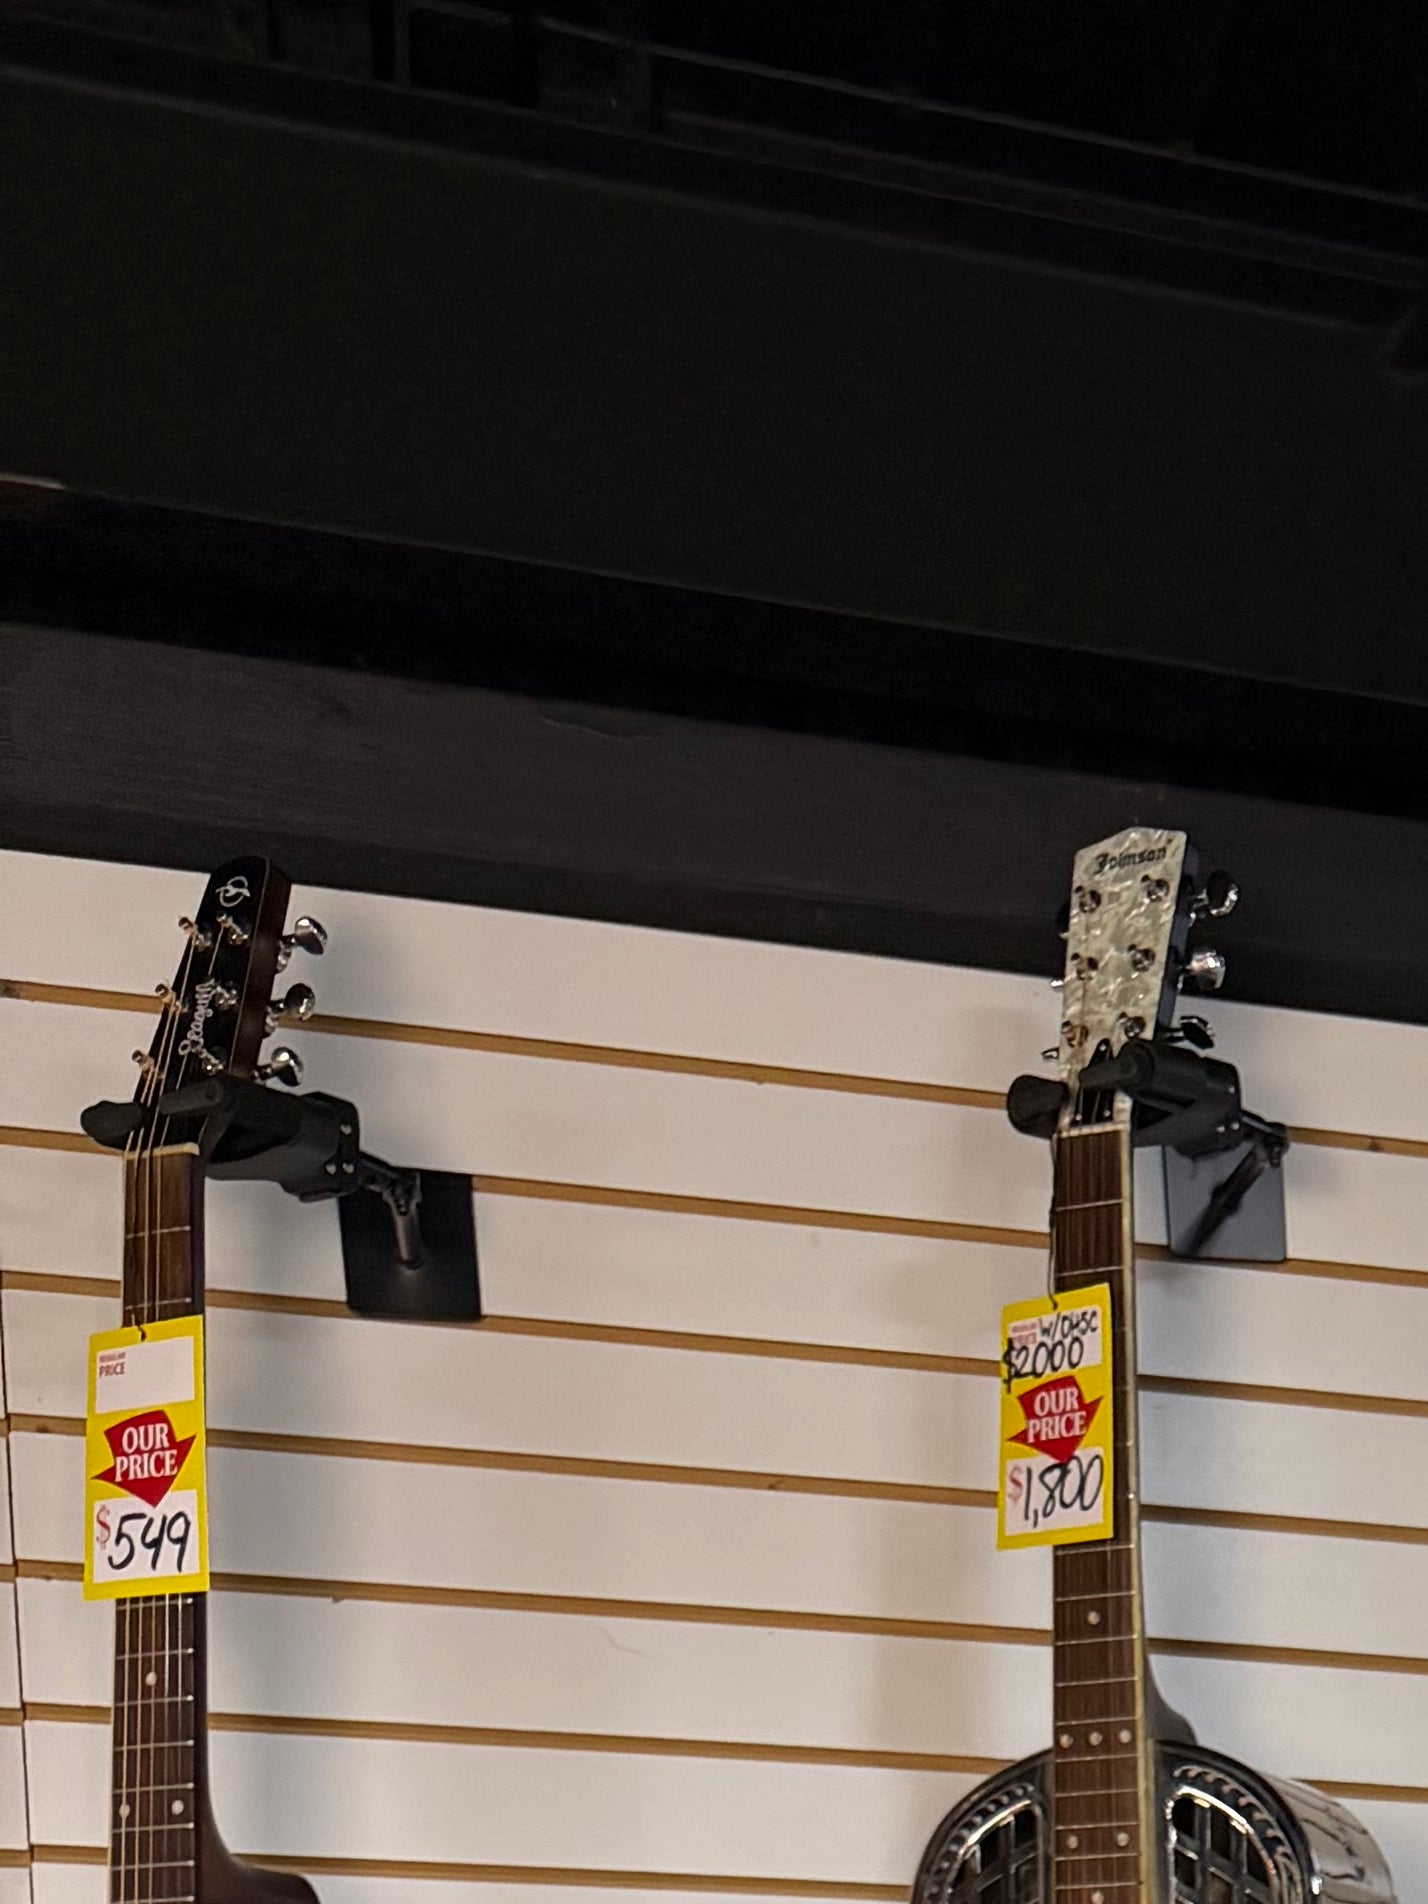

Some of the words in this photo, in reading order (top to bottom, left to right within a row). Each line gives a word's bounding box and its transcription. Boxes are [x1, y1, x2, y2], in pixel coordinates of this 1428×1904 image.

[99, 1363, 125, 1377] PRICE
[1003, 1337, 1084, 1394] $2000
[1034, 1387, 1079, 1417] OUR
[122, 1423, 169, 1454] OUR
[1027, 1412, 1087, 1443] PRICE
[114, 1450, 178, 1482] PRICE
[1008, 1455, 1104, 1529] $1,800
[96, 1505, 191, 1573] $549
